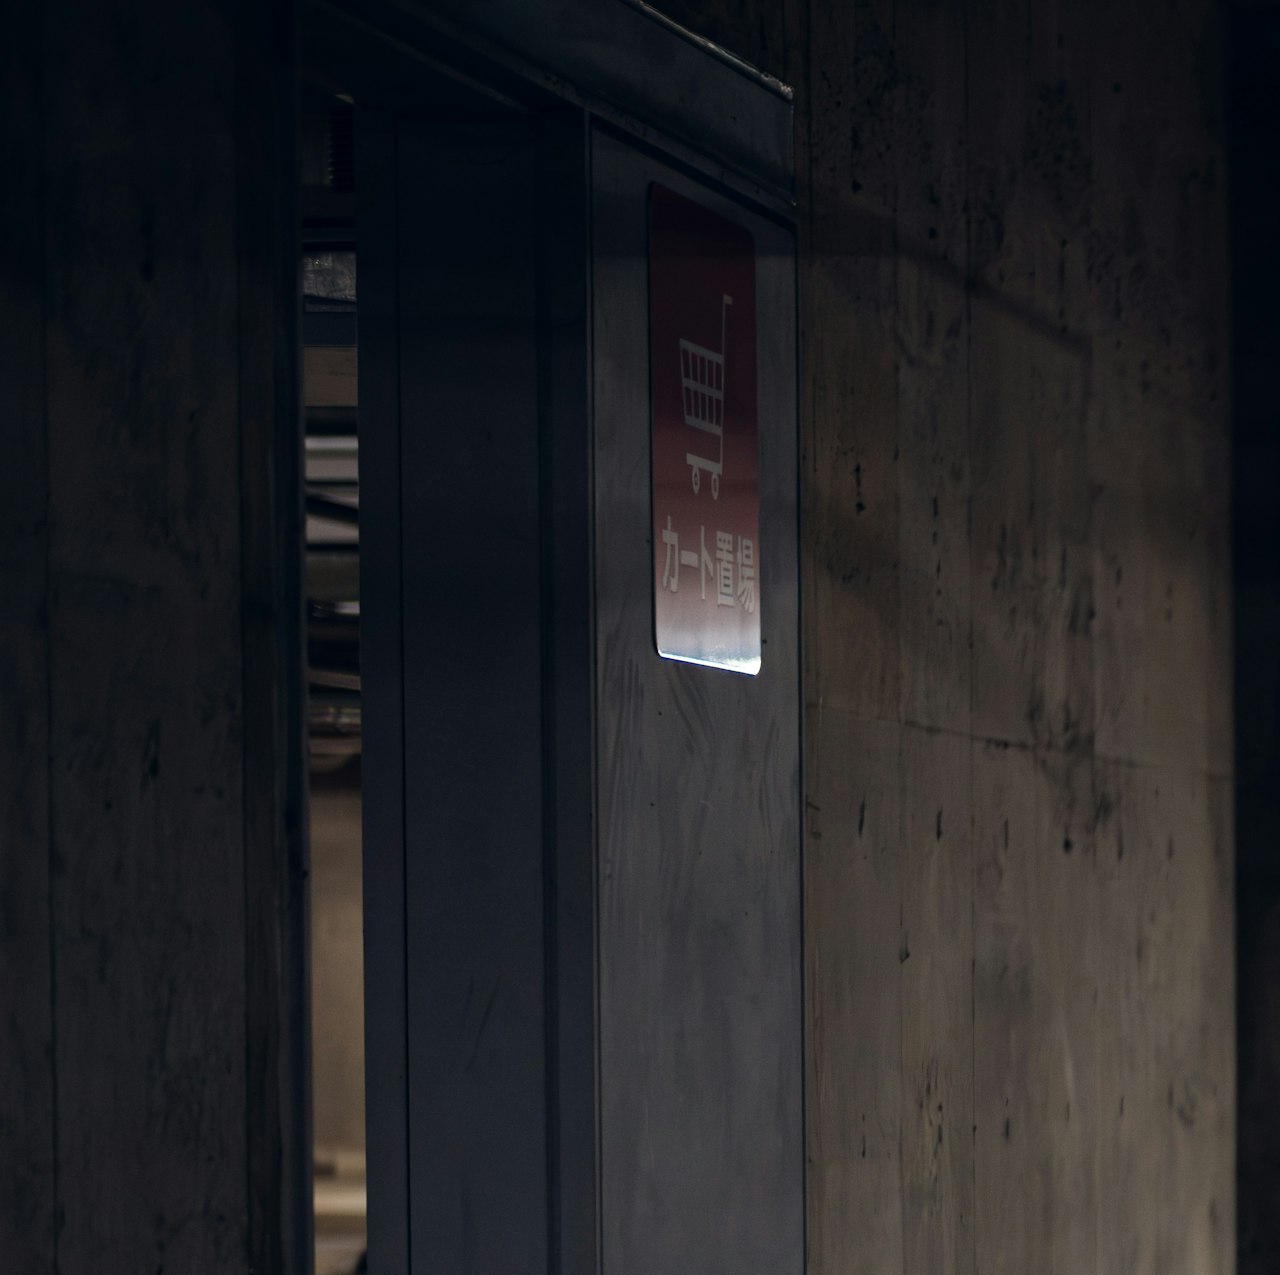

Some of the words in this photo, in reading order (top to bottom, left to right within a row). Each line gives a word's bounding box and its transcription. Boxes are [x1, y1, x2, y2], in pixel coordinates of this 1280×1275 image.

[662, 515, 755, 613] カート置場
